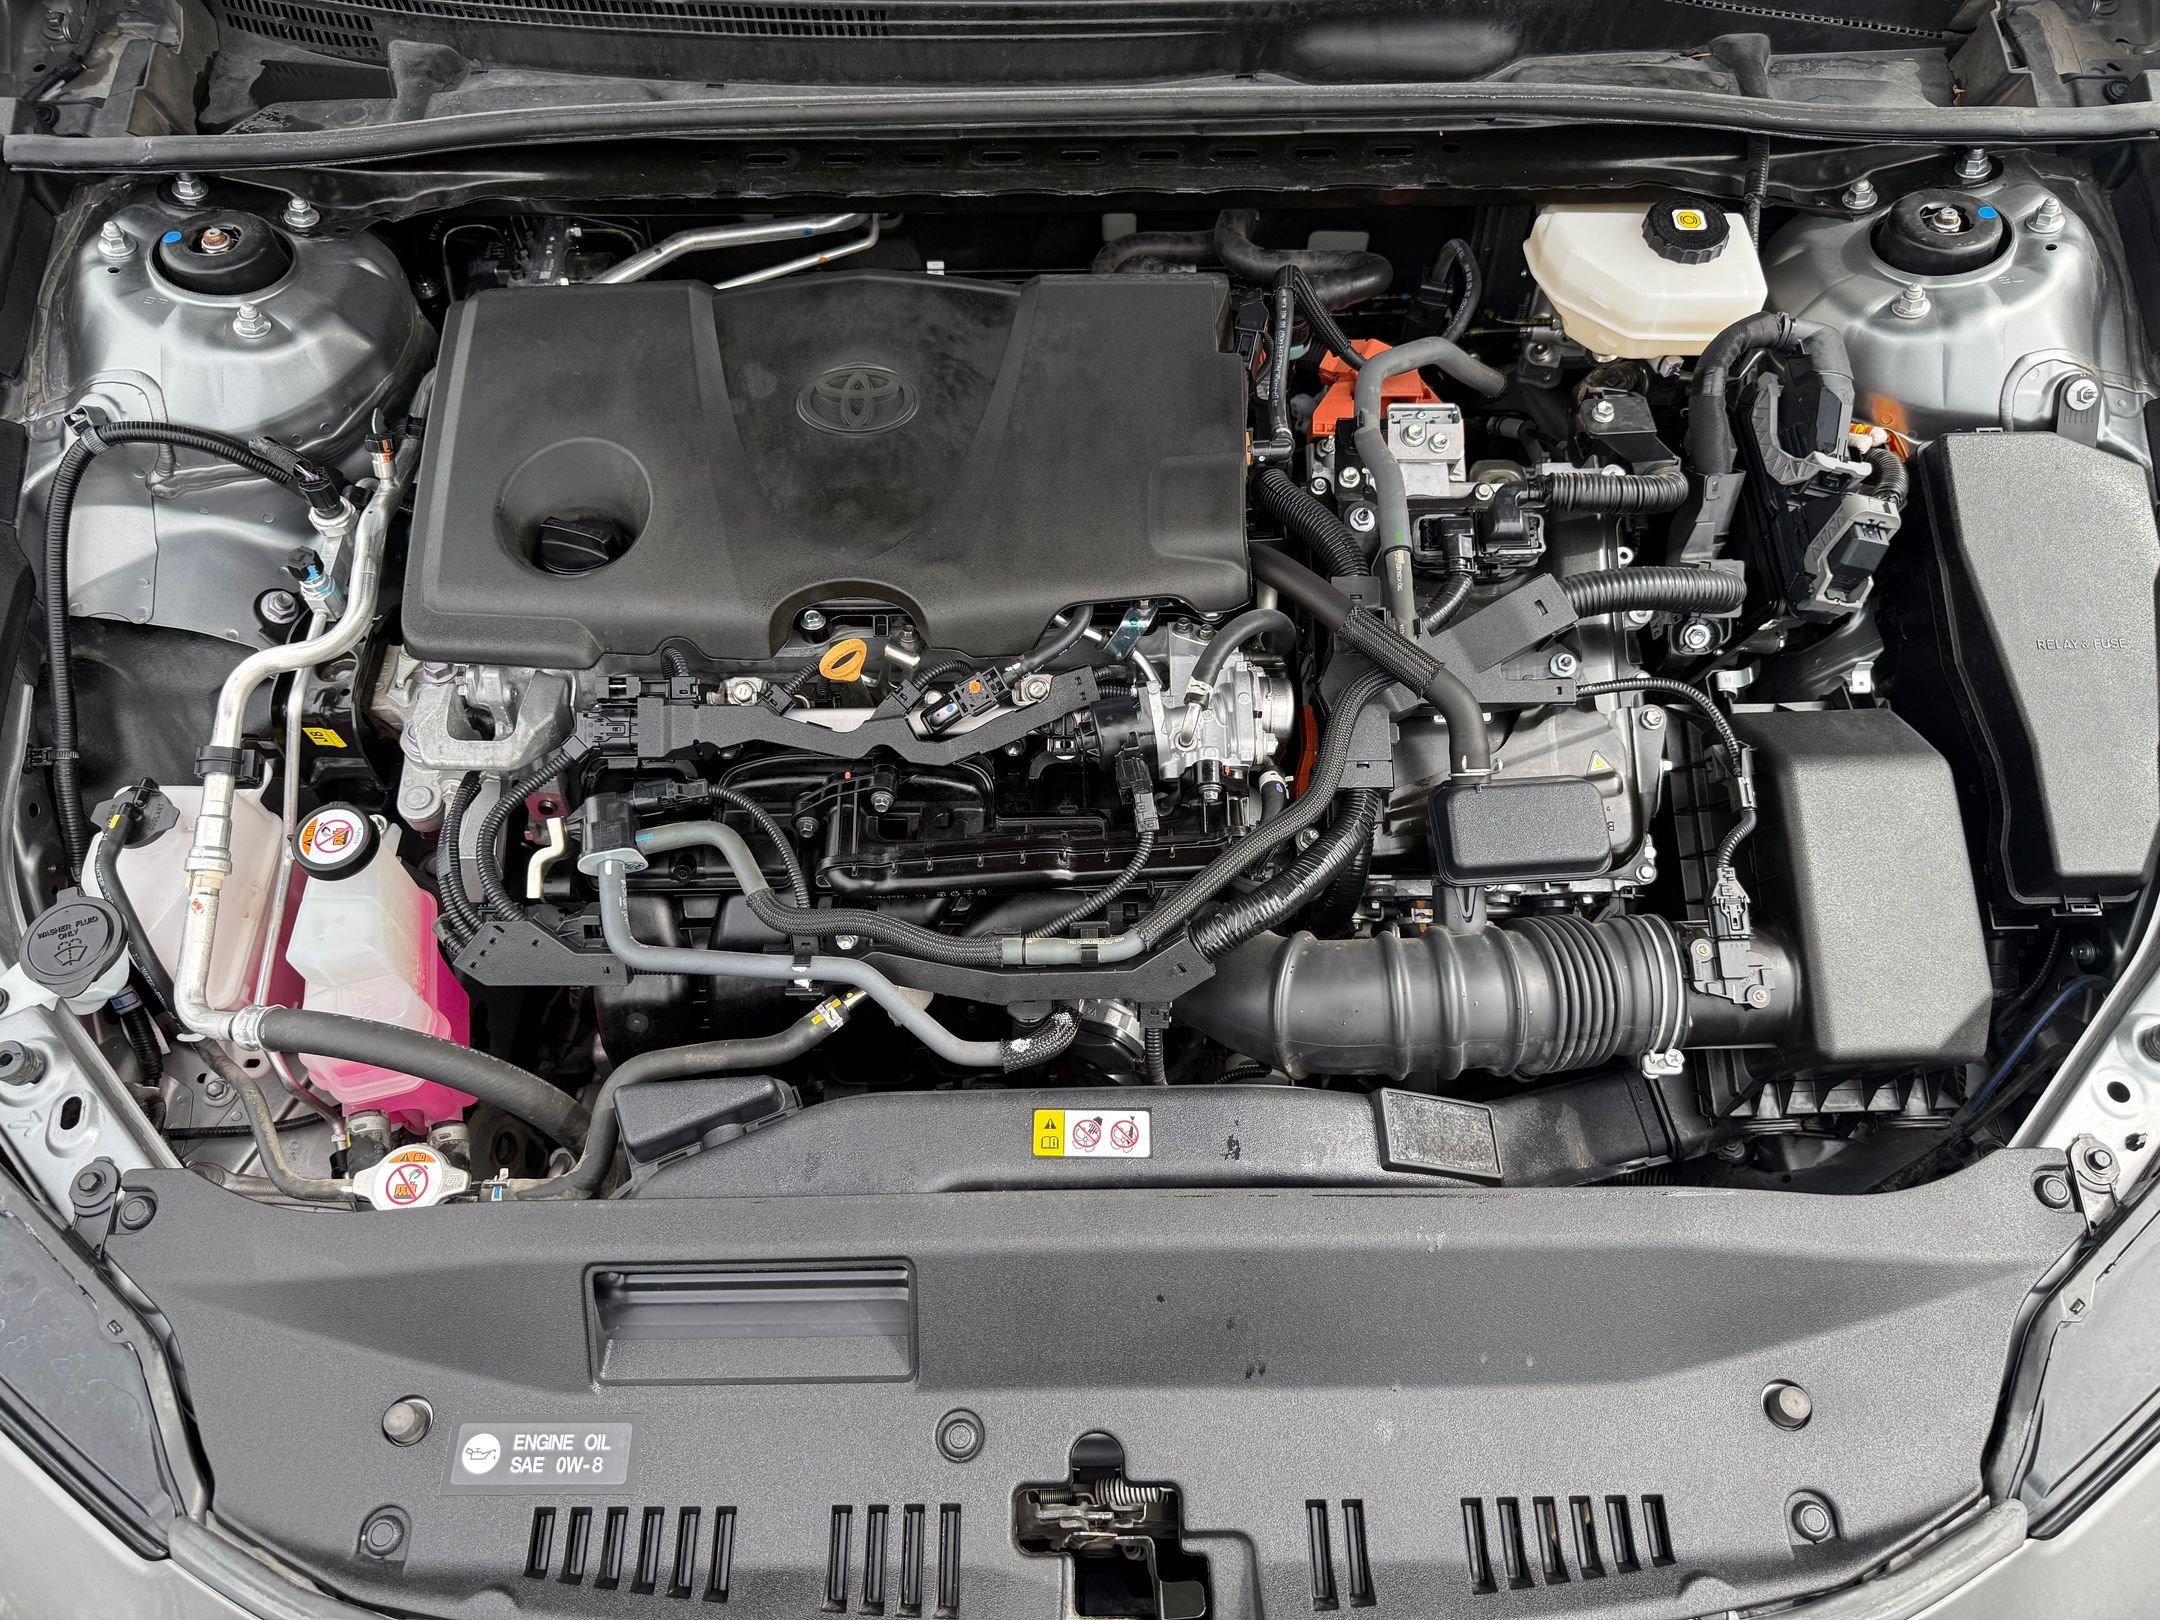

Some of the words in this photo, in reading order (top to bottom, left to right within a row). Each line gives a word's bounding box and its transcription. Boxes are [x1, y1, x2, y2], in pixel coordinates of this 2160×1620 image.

[2036, 639, 2077, 650] RELAY
[2081, 640, 2089, 649] &
[2093, 638, 2126, 649] FUSE
[37, 923, 72, 940] WASHER
[75, 916, 98, 928] FLUID
[58, 929, 80, 940] ONLY
[512, 1433, 575, 1451] ENGINE
[584, 1433, 611, 1451] OIL
[509, 1456, 545, 1474] SAE
[555, 1456, 604, 1474] 0W-8
